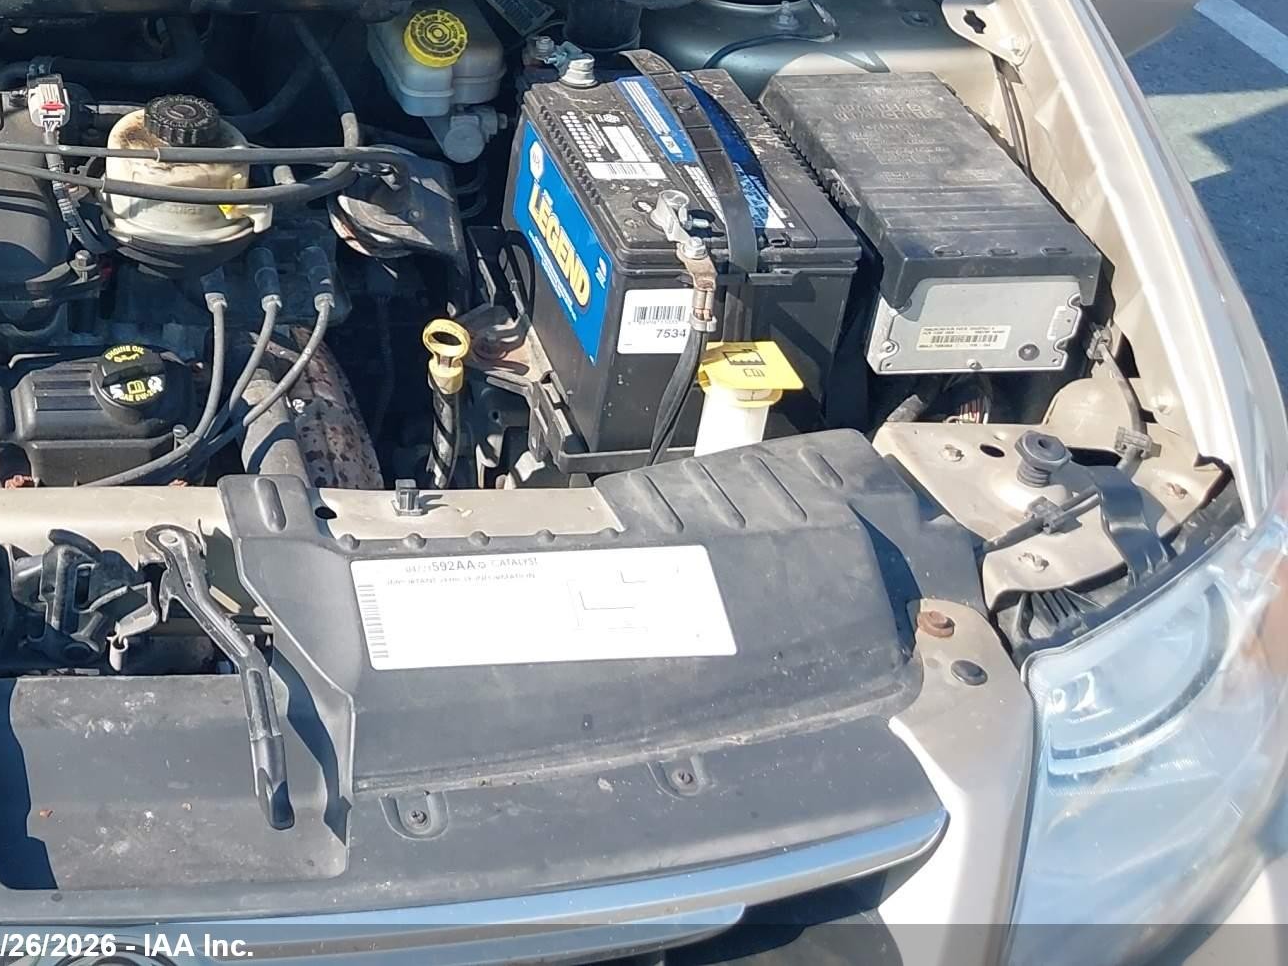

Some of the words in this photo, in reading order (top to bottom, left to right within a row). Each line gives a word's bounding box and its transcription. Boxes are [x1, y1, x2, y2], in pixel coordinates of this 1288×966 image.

[528, 184, 591, 307] LEGEND
[656, 328, 687, 339] 7534
[131, 345, 145, 355] OIL
